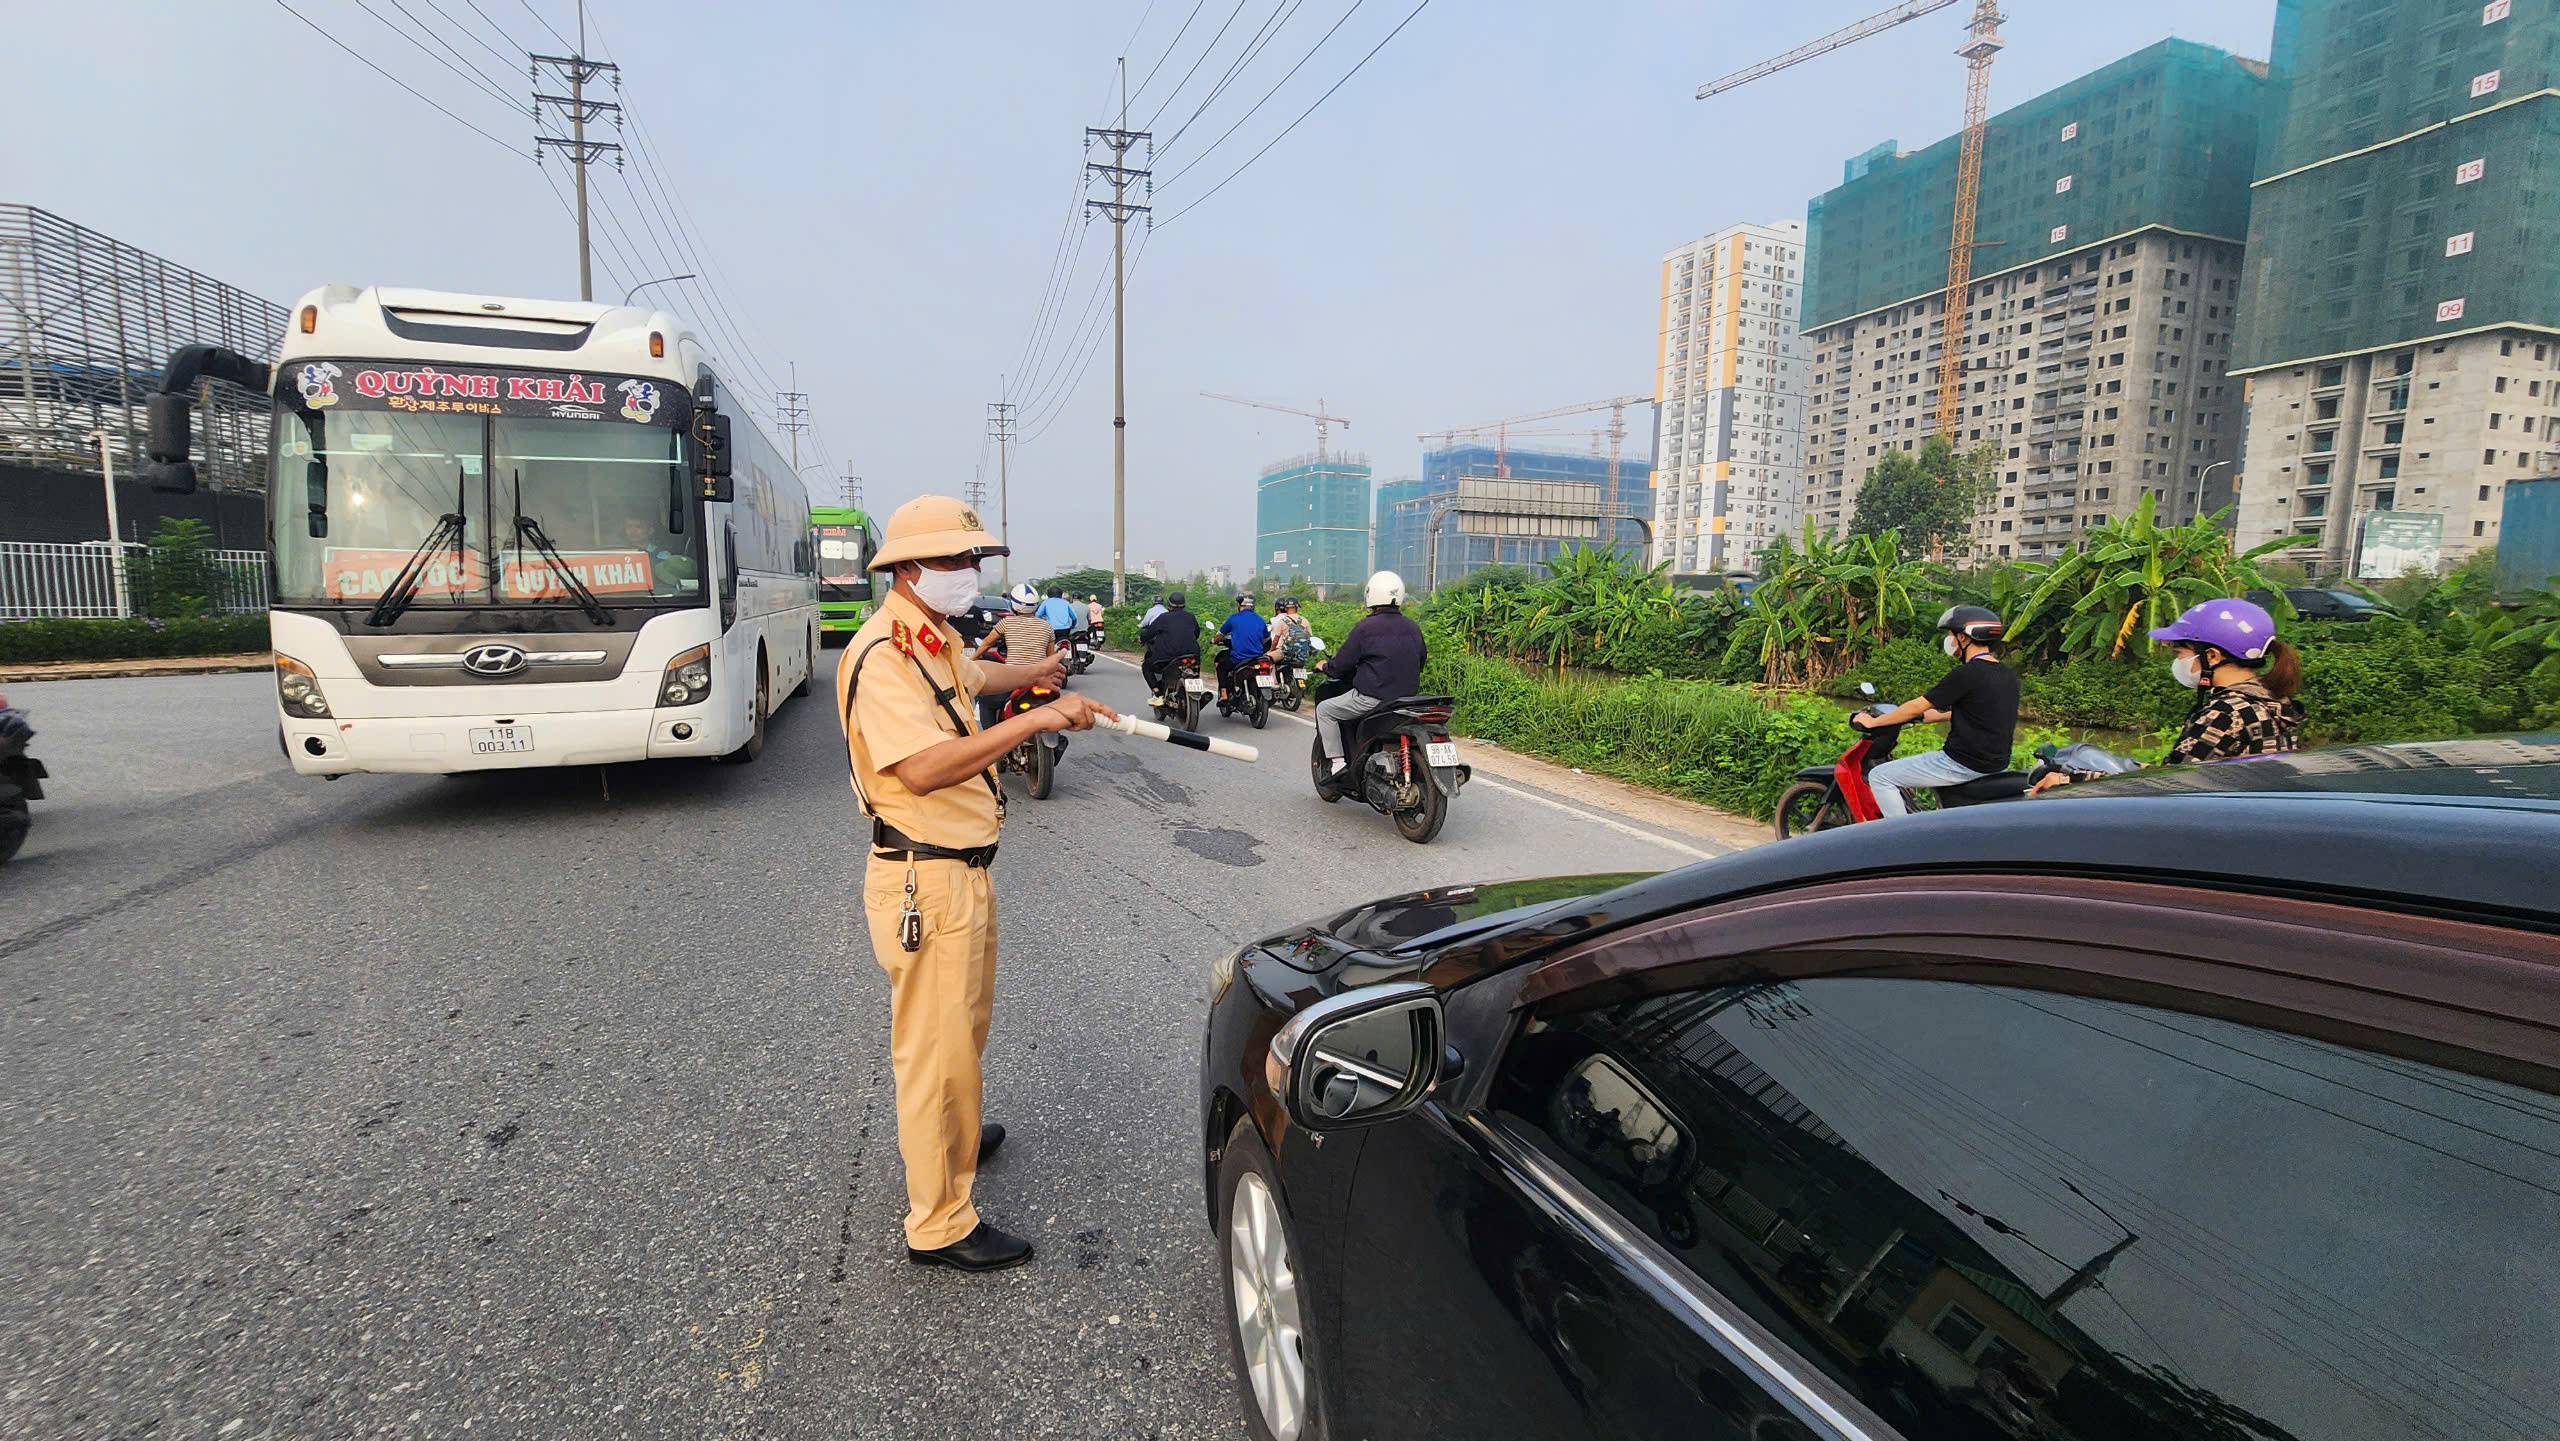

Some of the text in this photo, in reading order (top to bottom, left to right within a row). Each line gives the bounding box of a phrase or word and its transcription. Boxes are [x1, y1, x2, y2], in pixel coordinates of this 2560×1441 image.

[2486, 1, 2509, 21] 17
[2474, 75, 2498, 93] 15
[2063, 126, 2075, 138] 19
[2459, 163, 2481, 180] 13
[2057, 178, 2071, 191] 17
[2052, 228, 2065, 240] 15
[2449, 236, 2469, 252] 11
[2439, 303, 2461, 319] 09
[355, 367, 606, 404] QUỲNH KHẢI
[551, 410, 600, 421] HYUNDAI
[593, 555, 645, 587] KHẢI
[489, 728, 514, 740] 11B
[478, 739, 526, 752] 003.11
